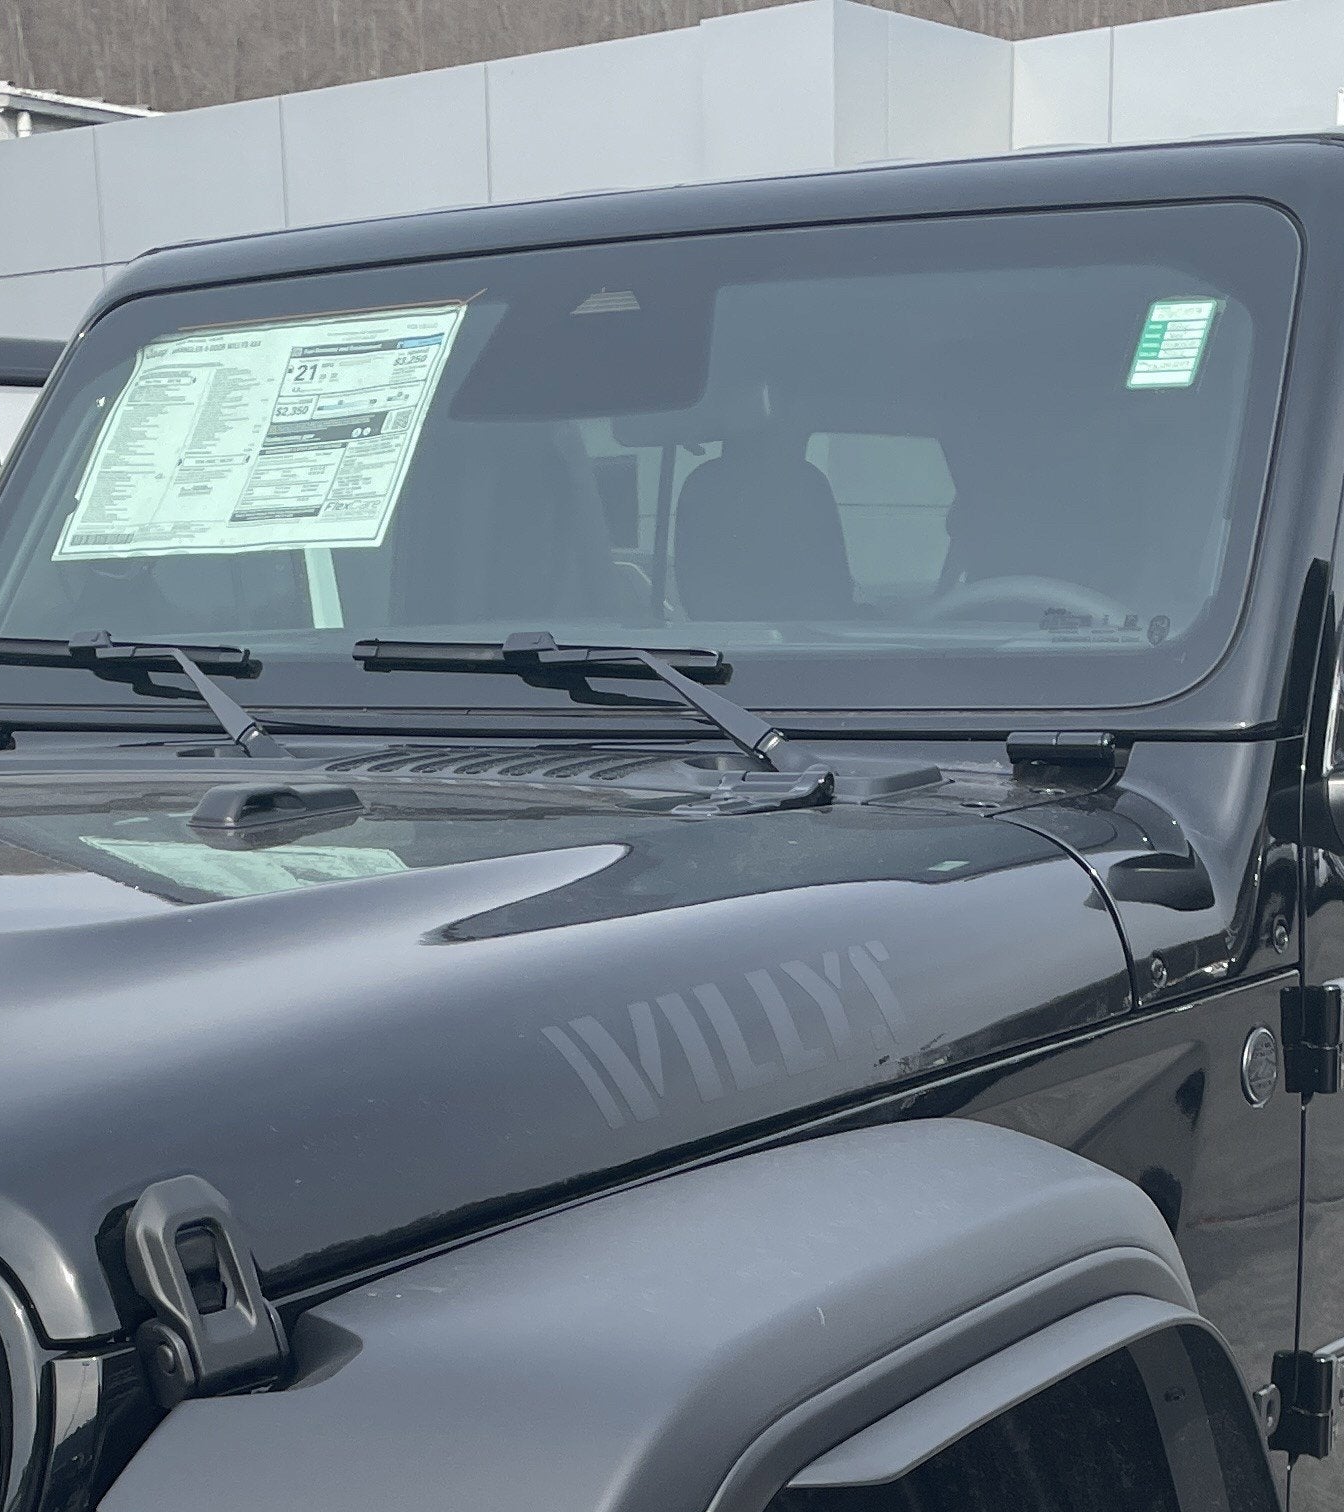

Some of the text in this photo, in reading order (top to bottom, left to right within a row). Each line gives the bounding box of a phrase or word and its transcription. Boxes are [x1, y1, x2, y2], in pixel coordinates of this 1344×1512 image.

[392, 353, 429, 367] $3,250
[294, 363, 319, 383] 21
[275, 405, 309, 417] $2,350
[541, 940, 908, 1129] WILLYS
